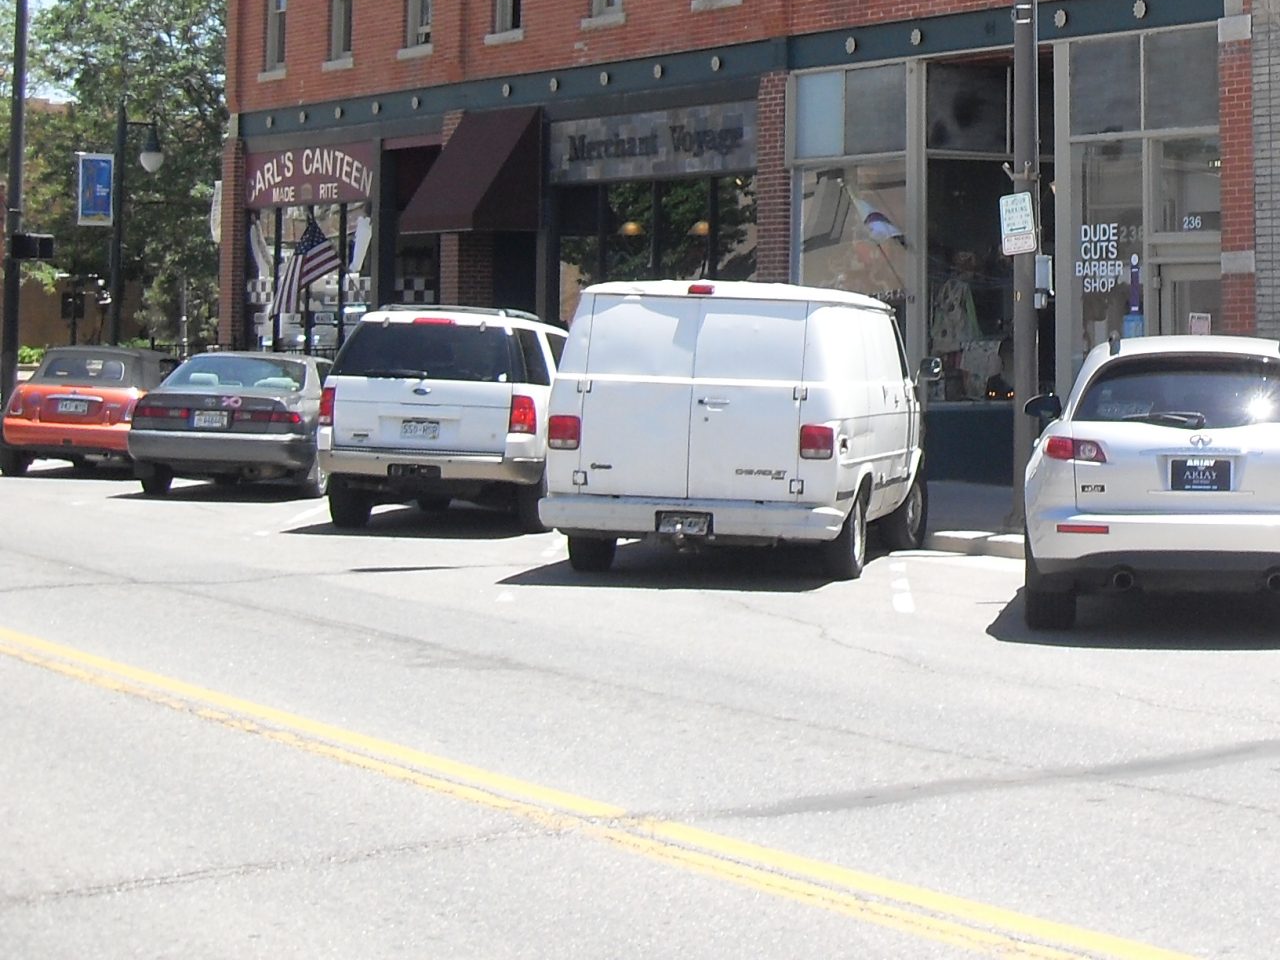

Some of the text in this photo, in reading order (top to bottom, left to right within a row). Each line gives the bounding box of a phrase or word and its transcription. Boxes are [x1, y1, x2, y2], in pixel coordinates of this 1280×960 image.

[302, 147, 373, 198] CANTEEN
[272, 182, 338, 202] MADE RITE
[1182, 216, 1202, 229] 236
[1081, 223, 1118, 241] DUDE
[1081, 241, 1118, 259] CUTS
[1075, 261, 1123, 276] BARBER
[1083, 278, 1115, 292] SHOP
